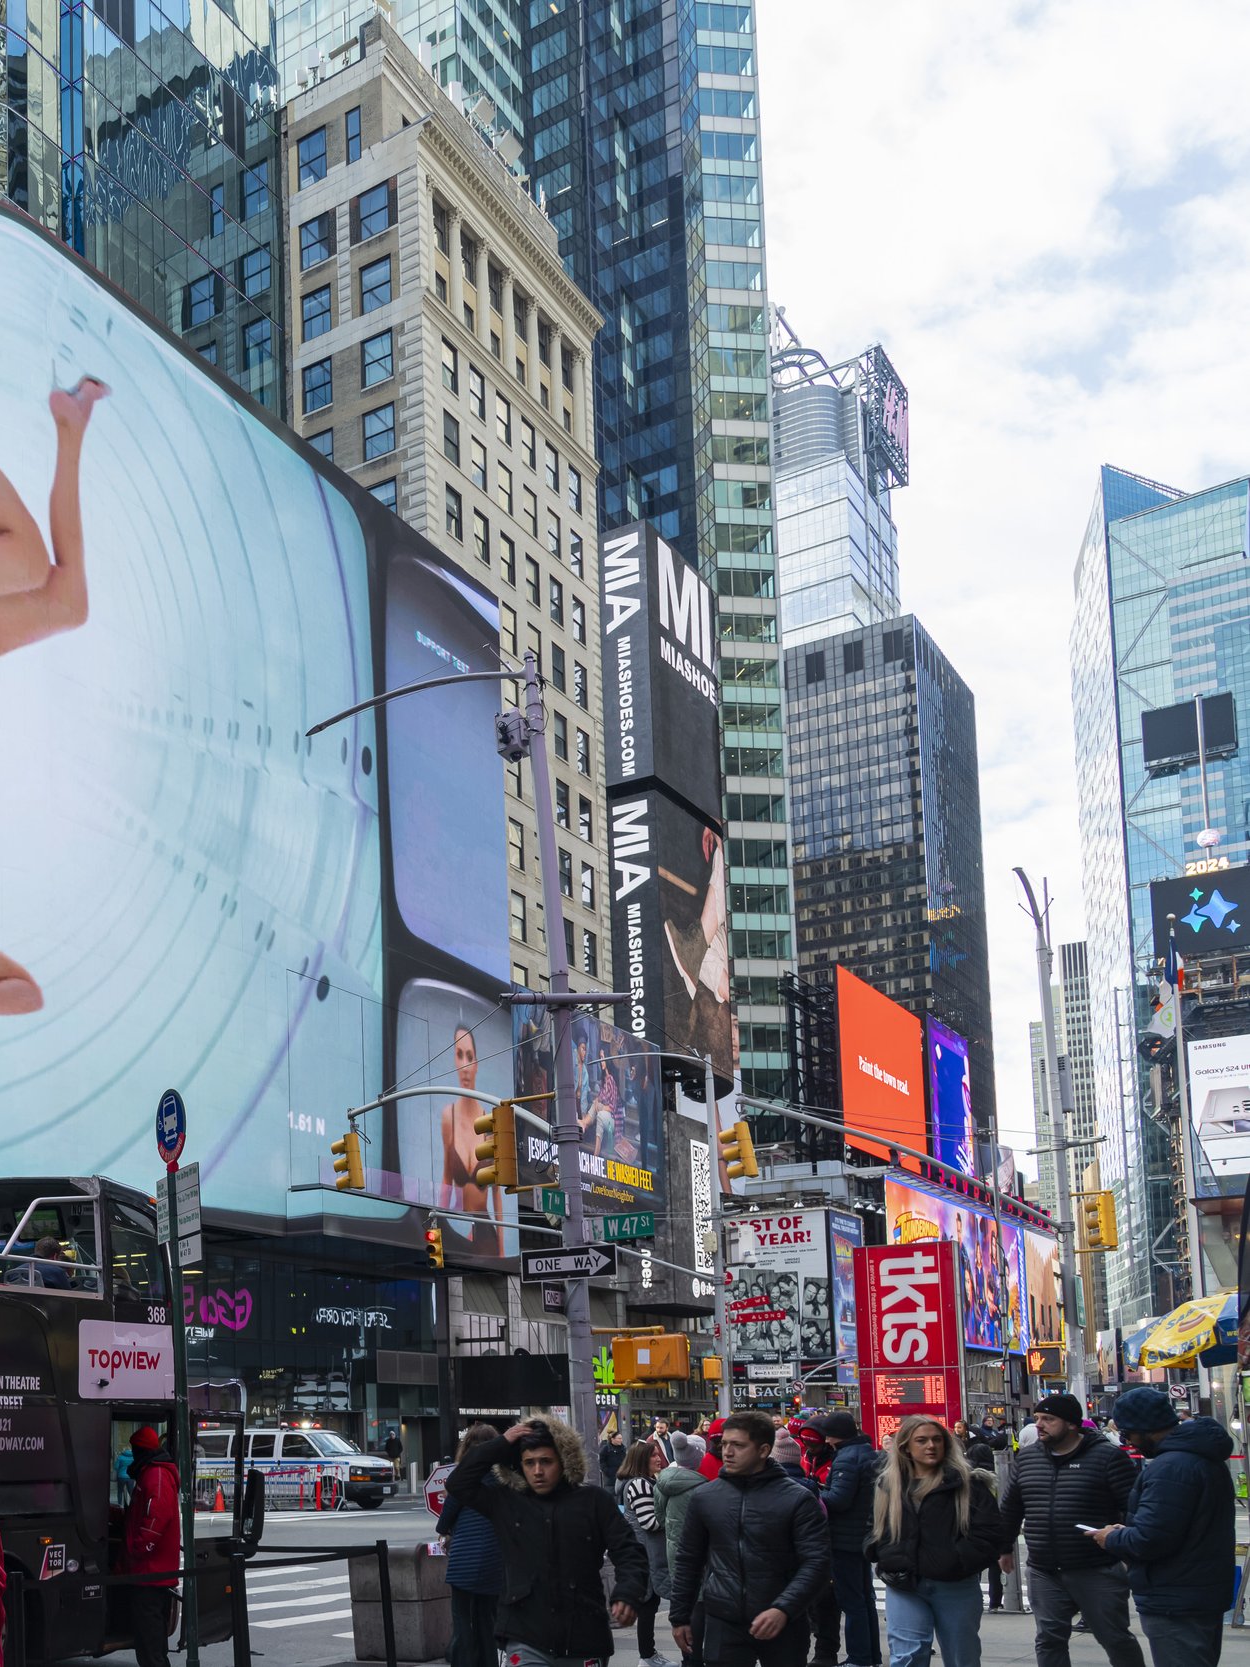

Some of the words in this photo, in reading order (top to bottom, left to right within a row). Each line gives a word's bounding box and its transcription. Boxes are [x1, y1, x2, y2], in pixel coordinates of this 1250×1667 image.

[603, 530, 640, 635] MIA
[451, 655, 470, 674] TEST
[617, 635, 636, 777] MIASHOES.COM
[612, 799, 650, 900] MIA
[1185, 857, 1229, 876] 2024
[1194, 1042, 1226, 1050] SAMSUNG
[858, 1055, 873, 1076] Paint
[873, 1063, 883, 1081] the
[883, 1069, 896, 1089] town
[1195, 1067, 1224, 1076] Galaxy
[1225, 1065, 1239, 1073] S24
[288, 1111, 312, 1133] 1.61
[316, 1118, 325, 1136] N
[528, 1136, 549, 1162] JESUS
[590, 1155, 607, 1178] HATE.
[607, 1160, 615, 1181] HE
[615, 1162, 639, 1187] WASHED
[608, 1219, 618, 1236] W
[622, 1217, 638, 1234] 47
[641, 1216, 649, 1226] St
[778, 1216, 803, 1229] OF
[757, 1231, 811, 1246] YEAR!
[535, 1259, 561, 1271] ONE
[574, 1256, 601, 1268] WAY
[546, 1292, 559, 1304] ONE
[879, 1251, 940, 1364] tkts
[148, 1305, 166, 1324] 368
[5, 1376, 40, 1390] THEATRE
[596, 1395, 616, 1405] CCER
[49, 1550, 62, 1559] VEC
[49, 1559, 62, 1567] TOR
